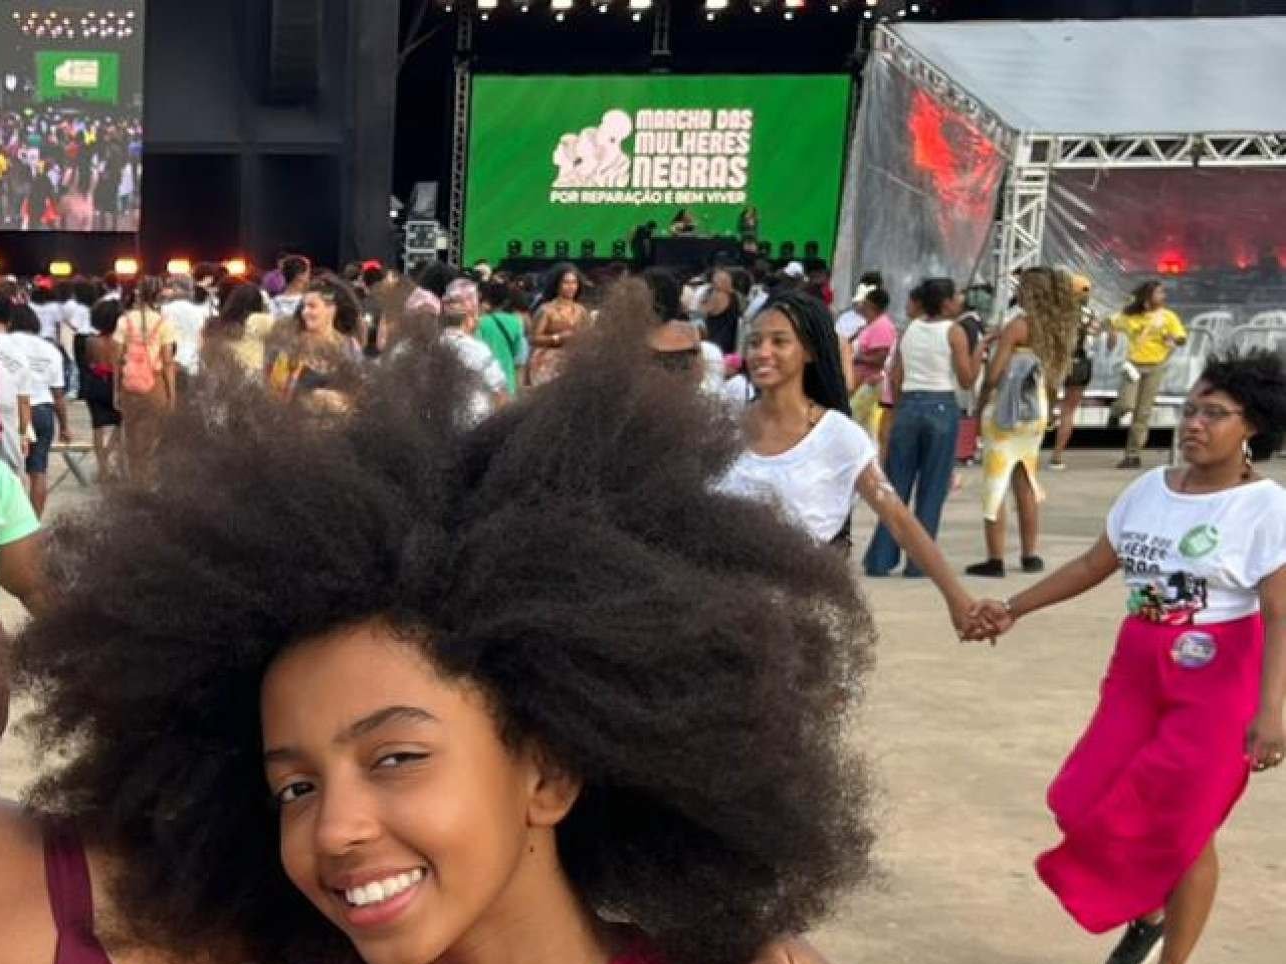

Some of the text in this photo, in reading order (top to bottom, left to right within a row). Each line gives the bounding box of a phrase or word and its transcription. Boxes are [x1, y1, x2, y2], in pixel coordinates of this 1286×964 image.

[635, 109, 753, 130] MARCHA DAS
[633, 131, 751, 154] MULHERES
[631, 155, 749, 188] NEGRAS
[550, 190, 579, 203] POR
[581, 188, 662, 206] REPARAÇÃO
